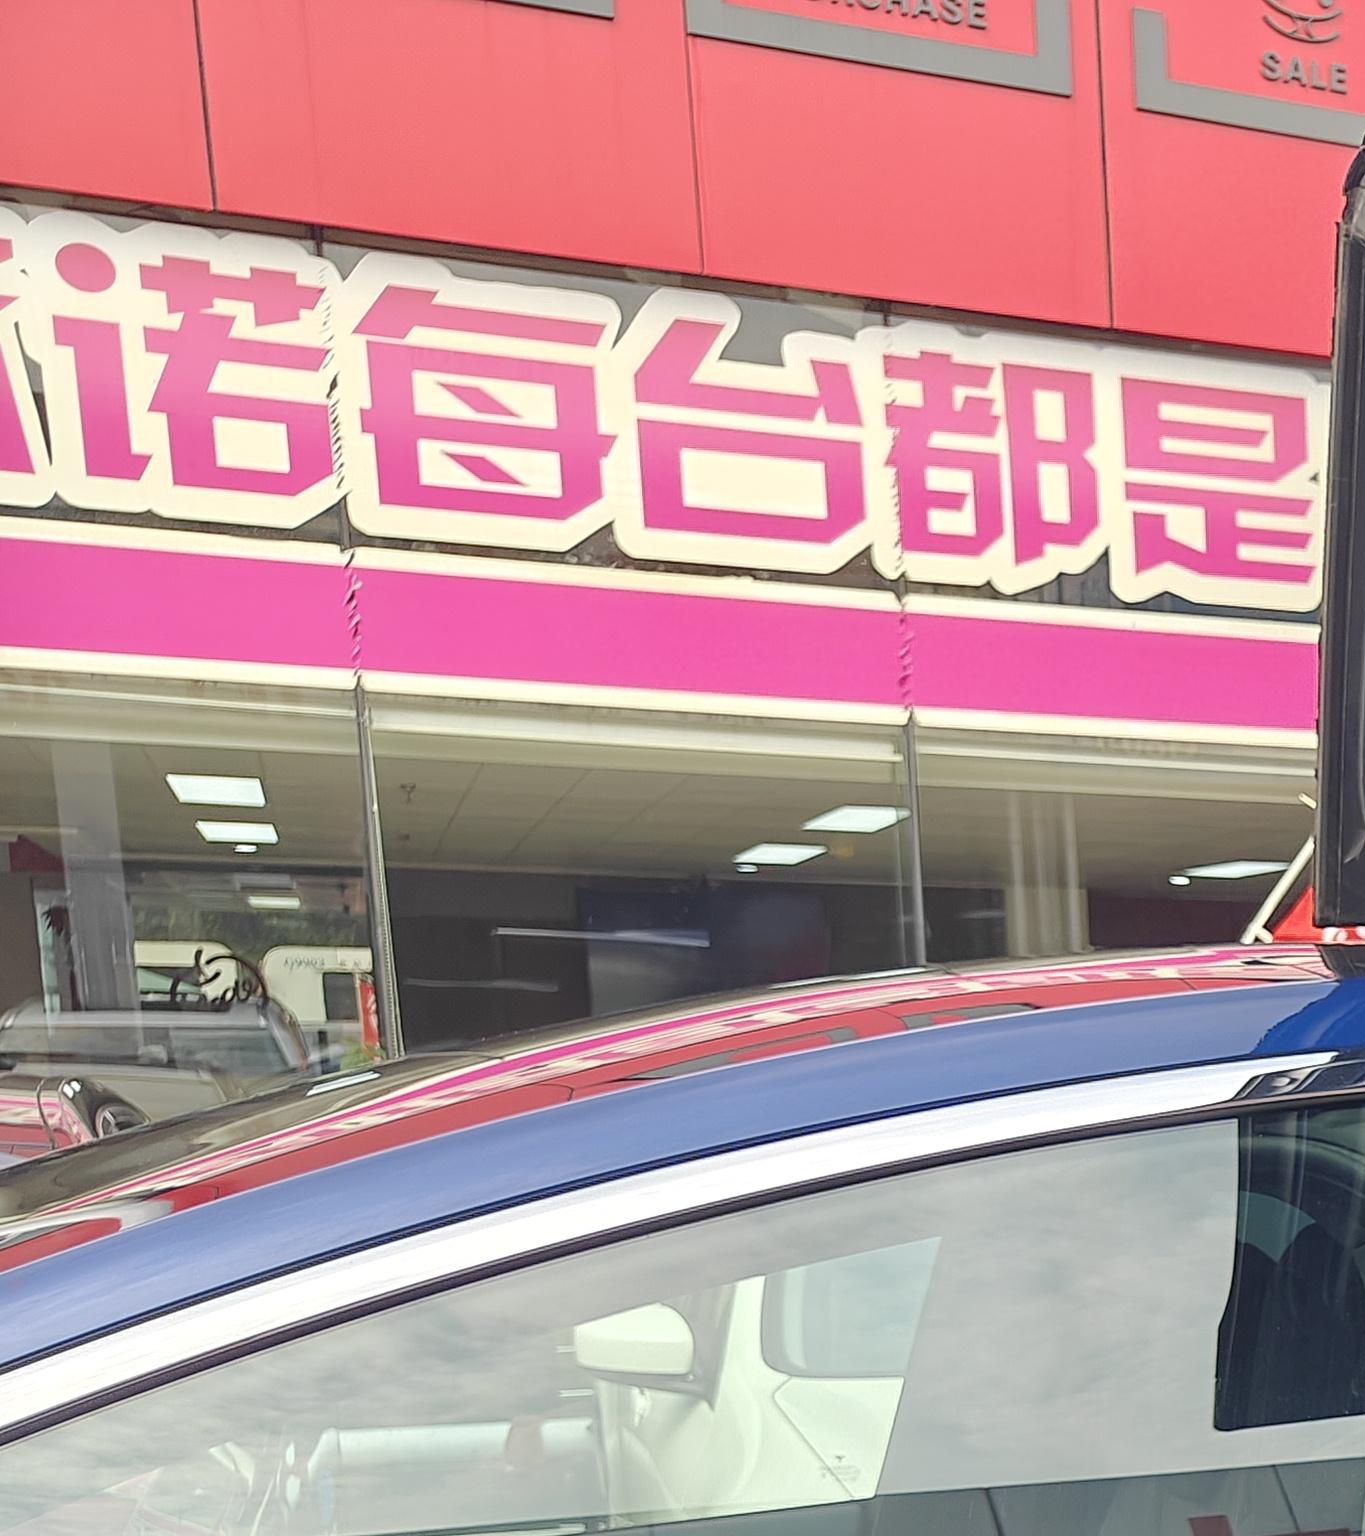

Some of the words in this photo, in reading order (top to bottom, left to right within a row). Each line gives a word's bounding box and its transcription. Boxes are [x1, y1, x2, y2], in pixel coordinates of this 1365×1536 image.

[806, 0, 987, 30] HASE
[1260, 51, 1348, 95] SALE
[0, 238, 1316, 584] 诺每台都是
